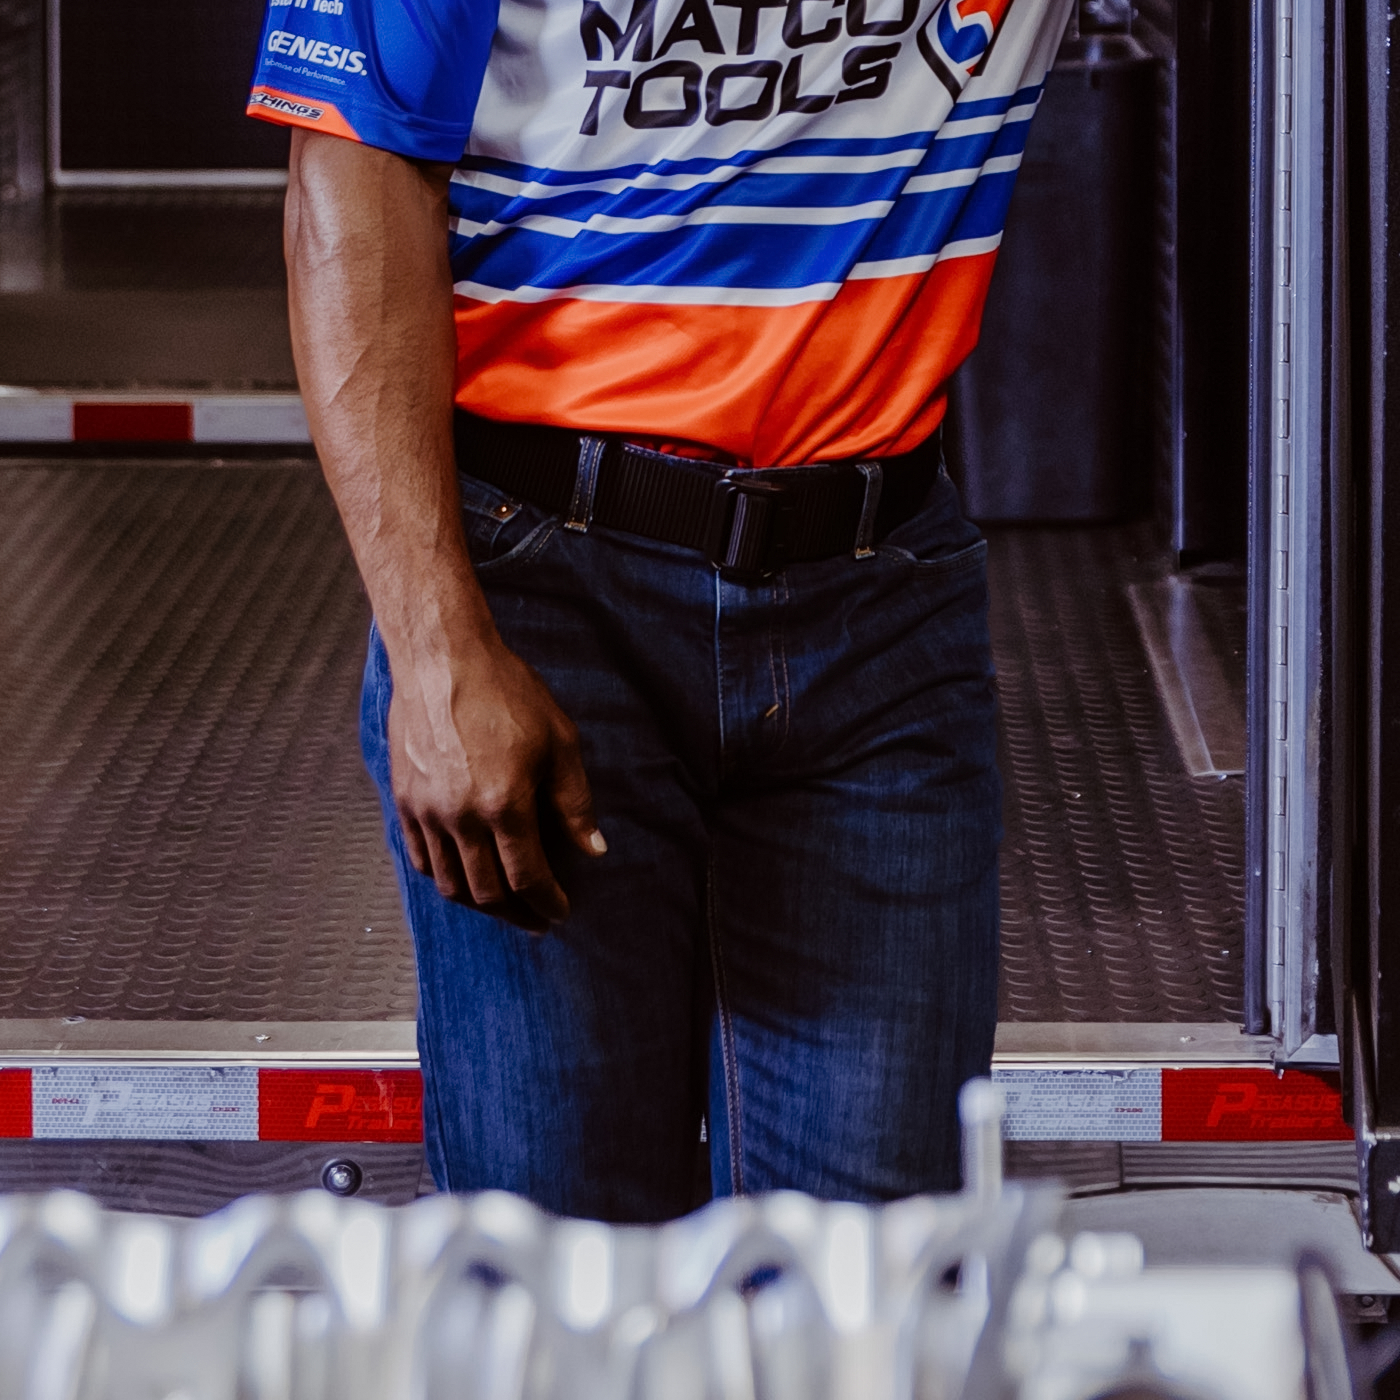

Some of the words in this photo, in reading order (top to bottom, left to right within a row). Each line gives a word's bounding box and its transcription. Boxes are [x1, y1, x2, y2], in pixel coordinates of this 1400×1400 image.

[579, 42, 902, 136] TOOLS
[304, 1084, 422, 1128] PEGASU
[347, 1115, 422, 1130] Trailer
[1206, 1083, 1341, 1127] PEGASUS
[1250, 1114, 1336, 1128] Trailers
